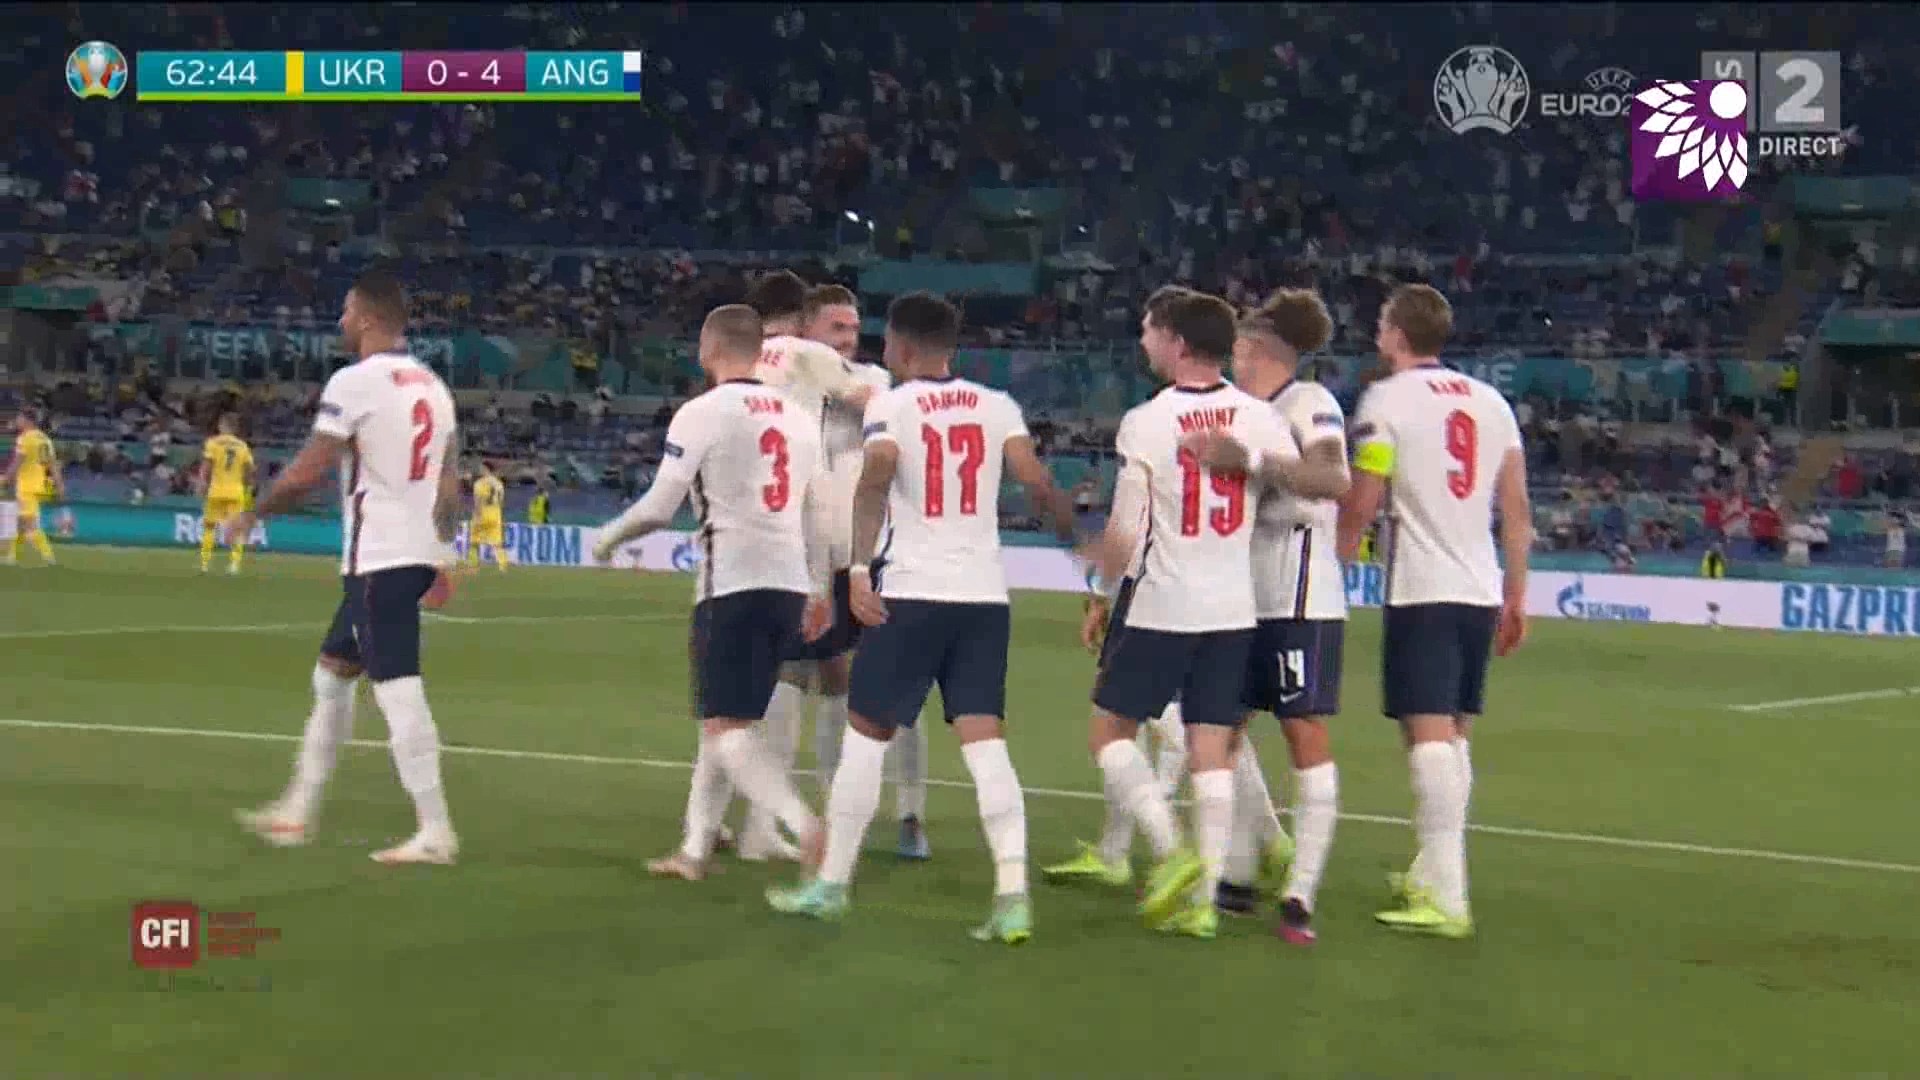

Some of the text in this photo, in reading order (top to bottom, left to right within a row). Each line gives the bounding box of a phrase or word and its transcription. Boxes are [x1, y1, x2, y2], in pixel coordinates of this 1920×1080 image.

[408, 398, 434, 481] 2
[1177, 407, 1237, 433] MOUNT
[1444, 408, 1479, 500] 9
[759, 426, 790, 513] 3
[920, 422, 986, 518] 17
[1176, 444, 1246, 537] 19
[1278, 650, 1305, 687] 14
